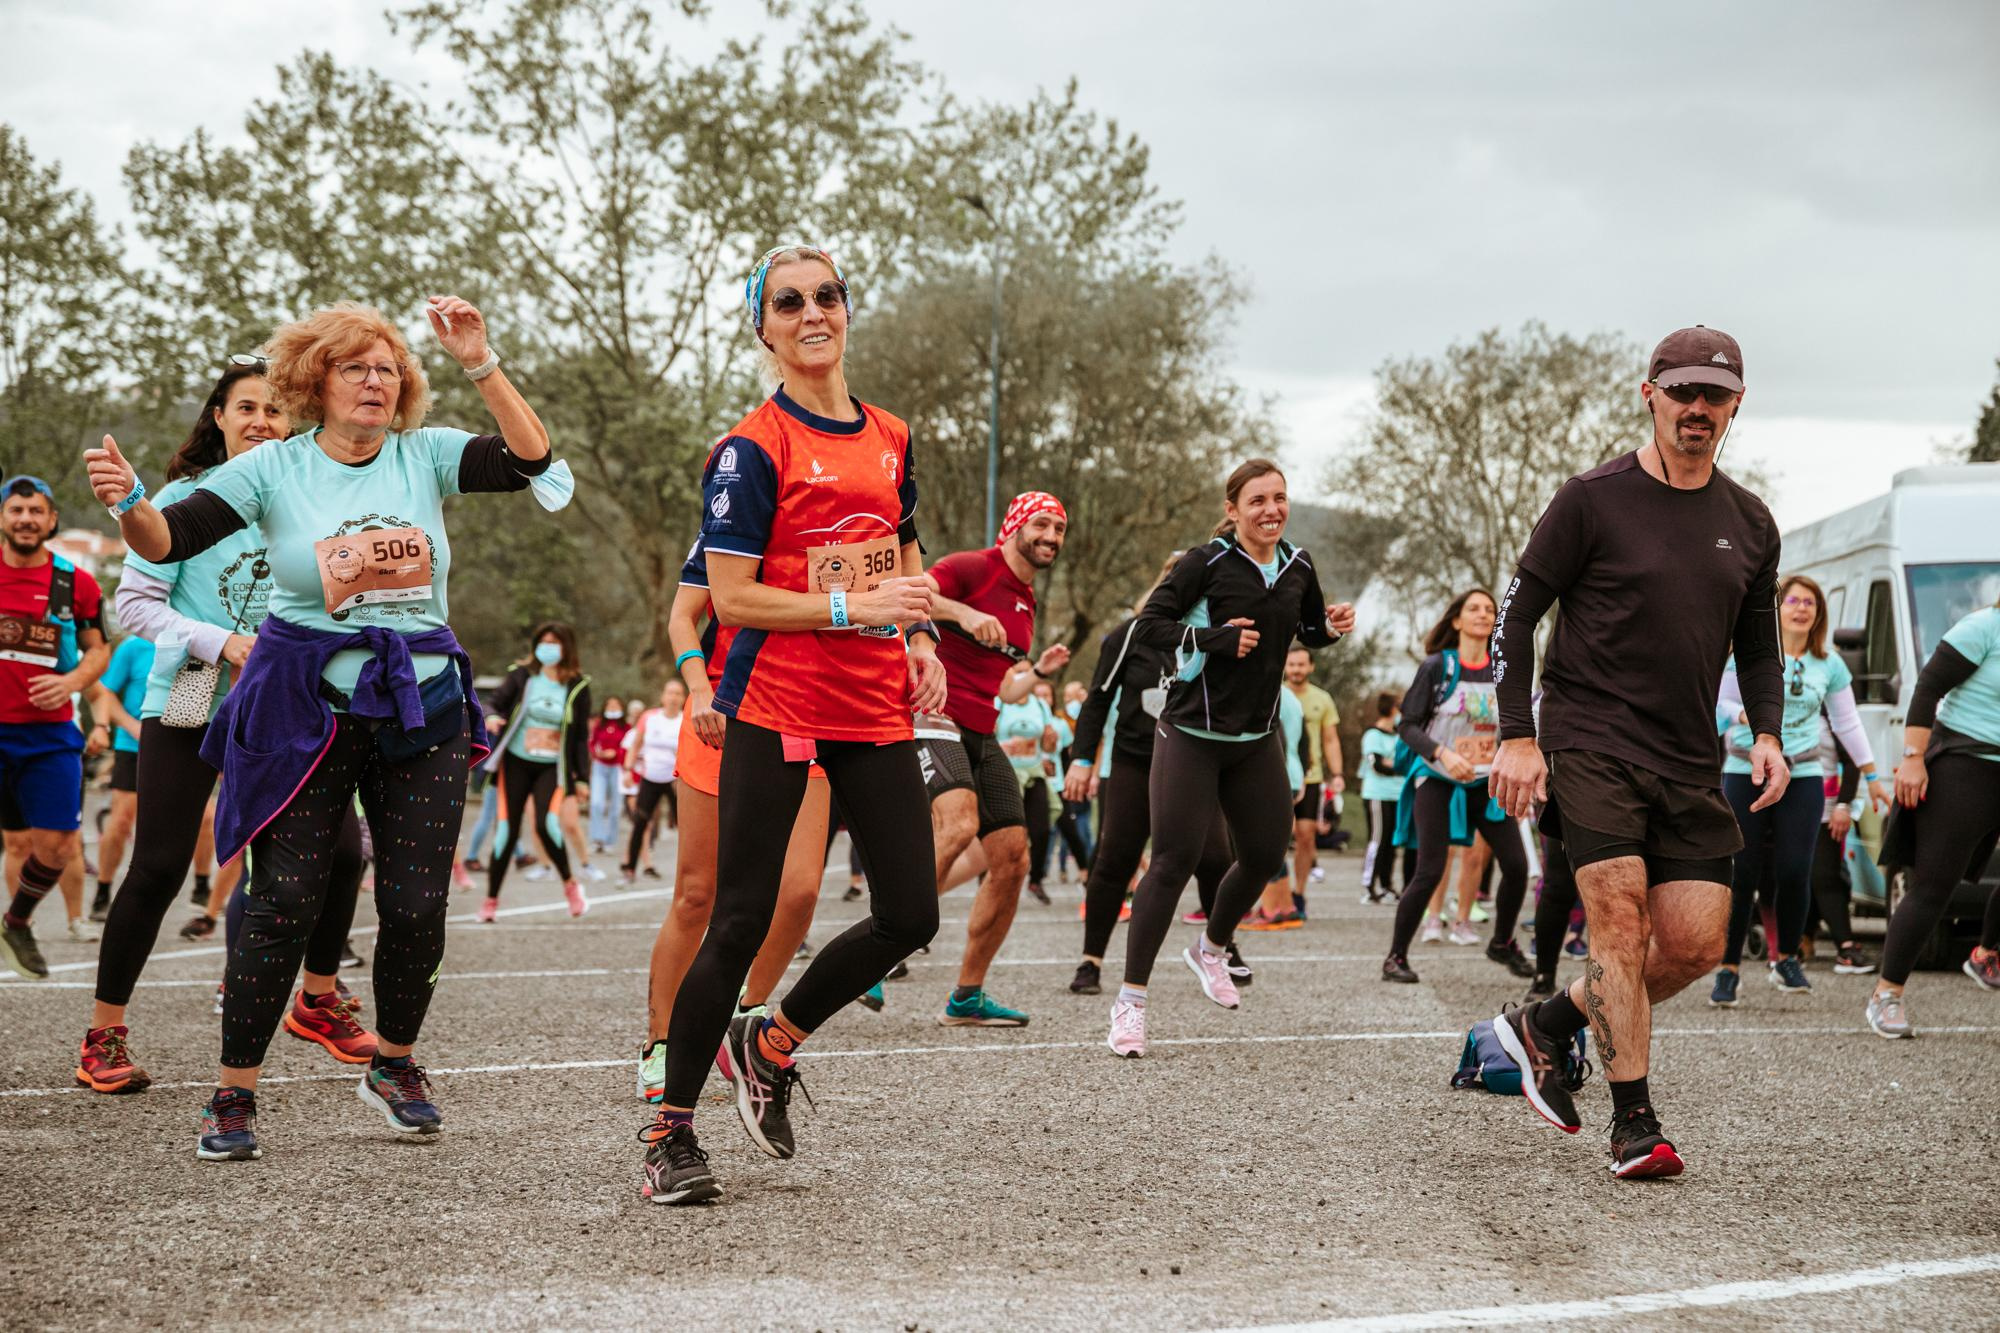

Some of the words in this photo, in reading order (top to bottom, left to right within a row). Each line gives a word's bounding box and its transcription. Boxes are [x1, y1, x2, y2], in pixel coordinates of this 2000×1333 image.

[372, 538, 420, 562] 506
[863, 549, 895, 576] 368
[232, 582, 274, 593] CORRIDA
[30, 624, 56, 642] 156
[917, 746, 937, 785] FILA
